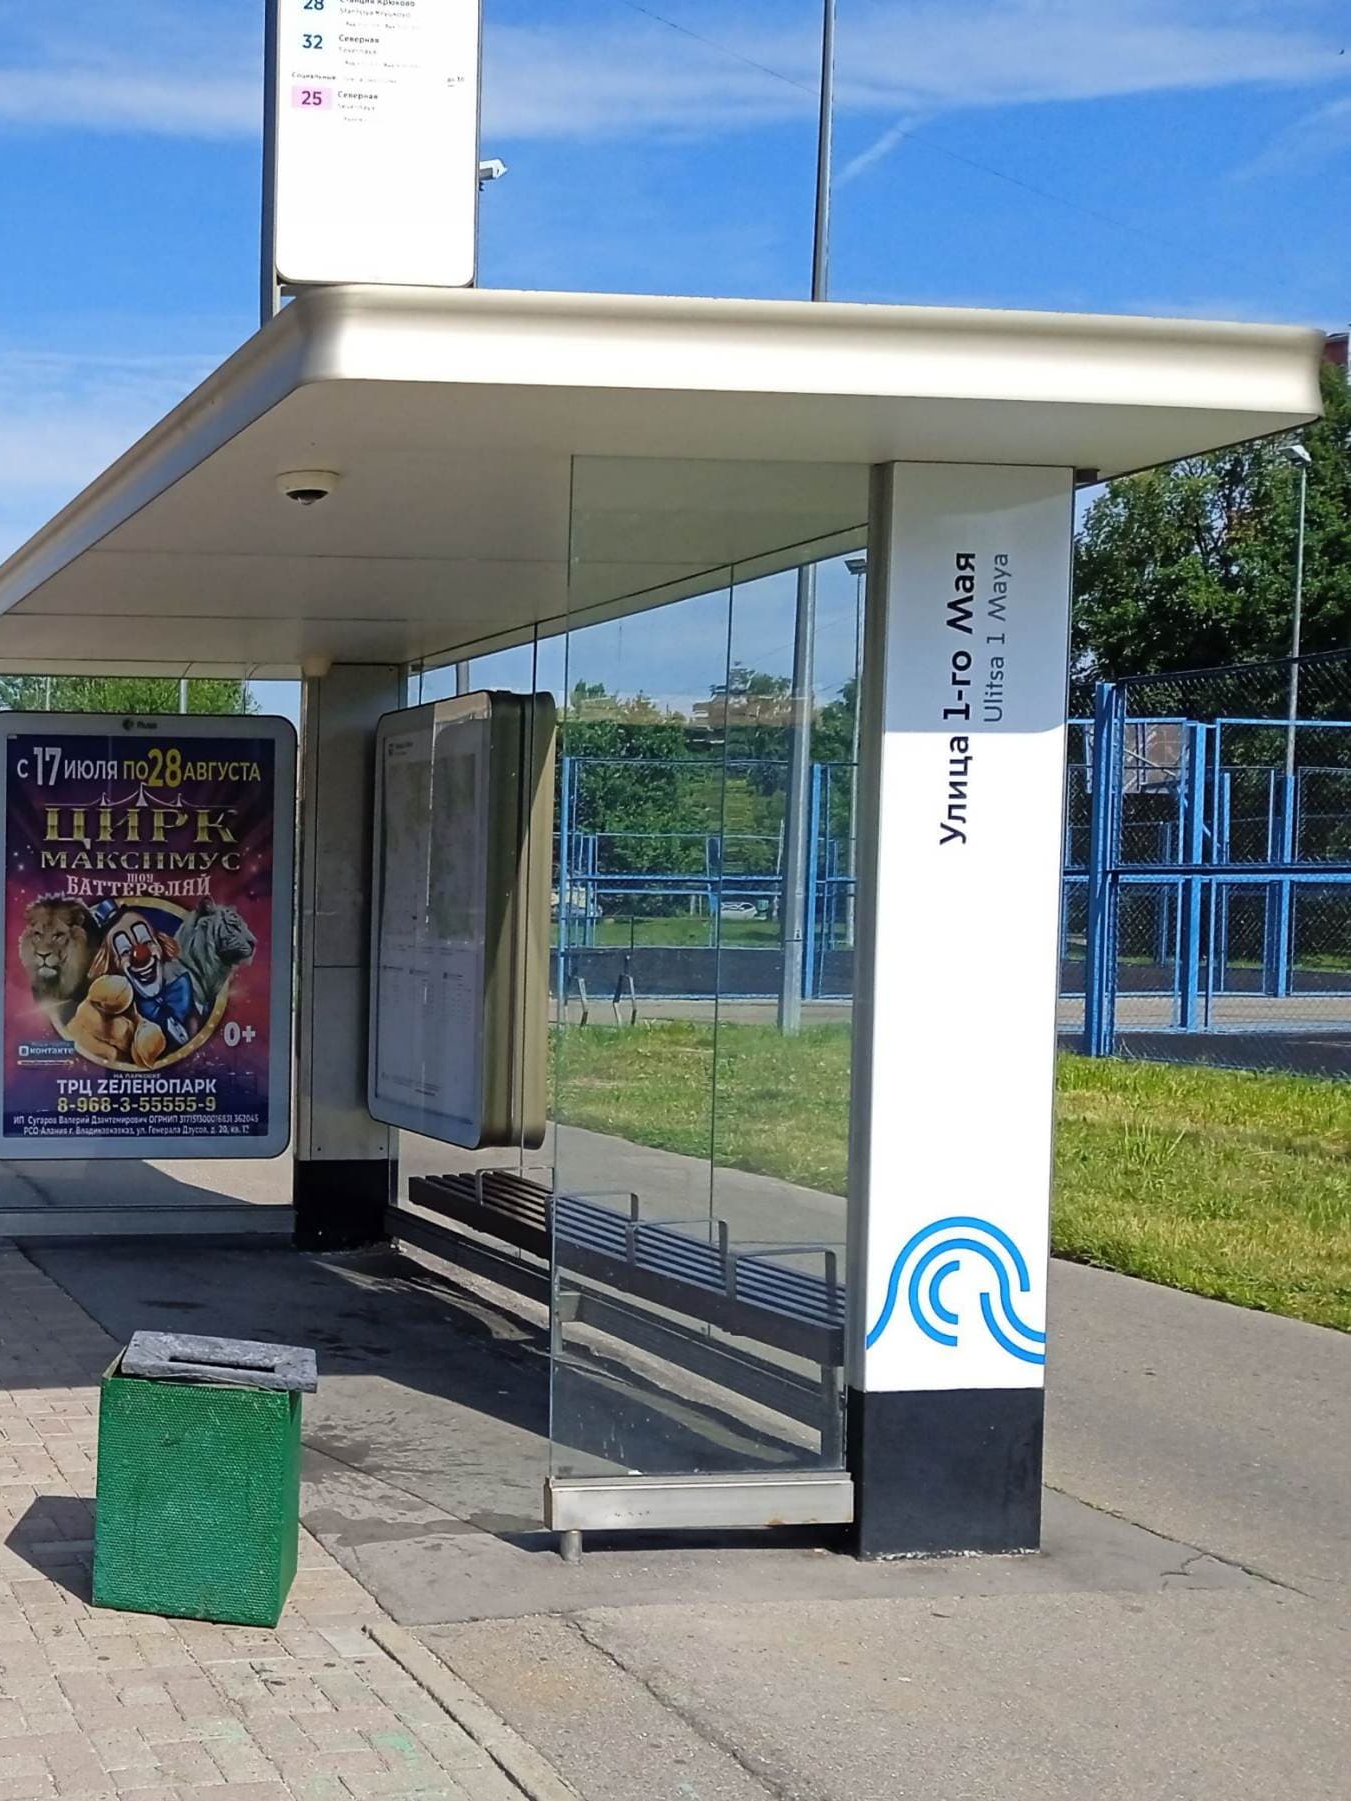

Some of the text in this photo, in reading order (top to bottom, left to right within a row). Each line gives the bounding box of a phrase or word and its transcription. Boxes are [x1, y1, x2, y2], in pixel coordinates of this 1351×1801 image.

[303, 0, 325, 11] 28
[302, 34, 323, 50] 32
[301, 90, 322, 106] 25
[983, 553, 1012, 723] Ulitsa 1 Maya
[939, 552, 976, 845] Улица 1-го Мая
[33, 747, 62, 786] 17
[64, 760, 117, 780] ИЮЛЯ
[123, 760, 148, 780] ПО
[148, 748, 182, 788] 28
[183, 762, 261, 781] АВГУСТА
[43, 808, 240, 849] ЦИРК
[41, 851, 240, 871] МАКСИМУС
[66, 874, 212, 897] БАТТЕРФЛЯЙ
[223, 1021, 257, 1047] 0+
[57, 1079, 92, 1096] ТРЦ
[57, 1096, 216, 1113] 8-968-3-55555-9
[13, 1116, 25, 1125] ИП
[58, 1114, 90, 1125] Валерий
[149, 1114, 178, 1123] ОГРНИП
[149, 1126, 181, 1135] Генерала
